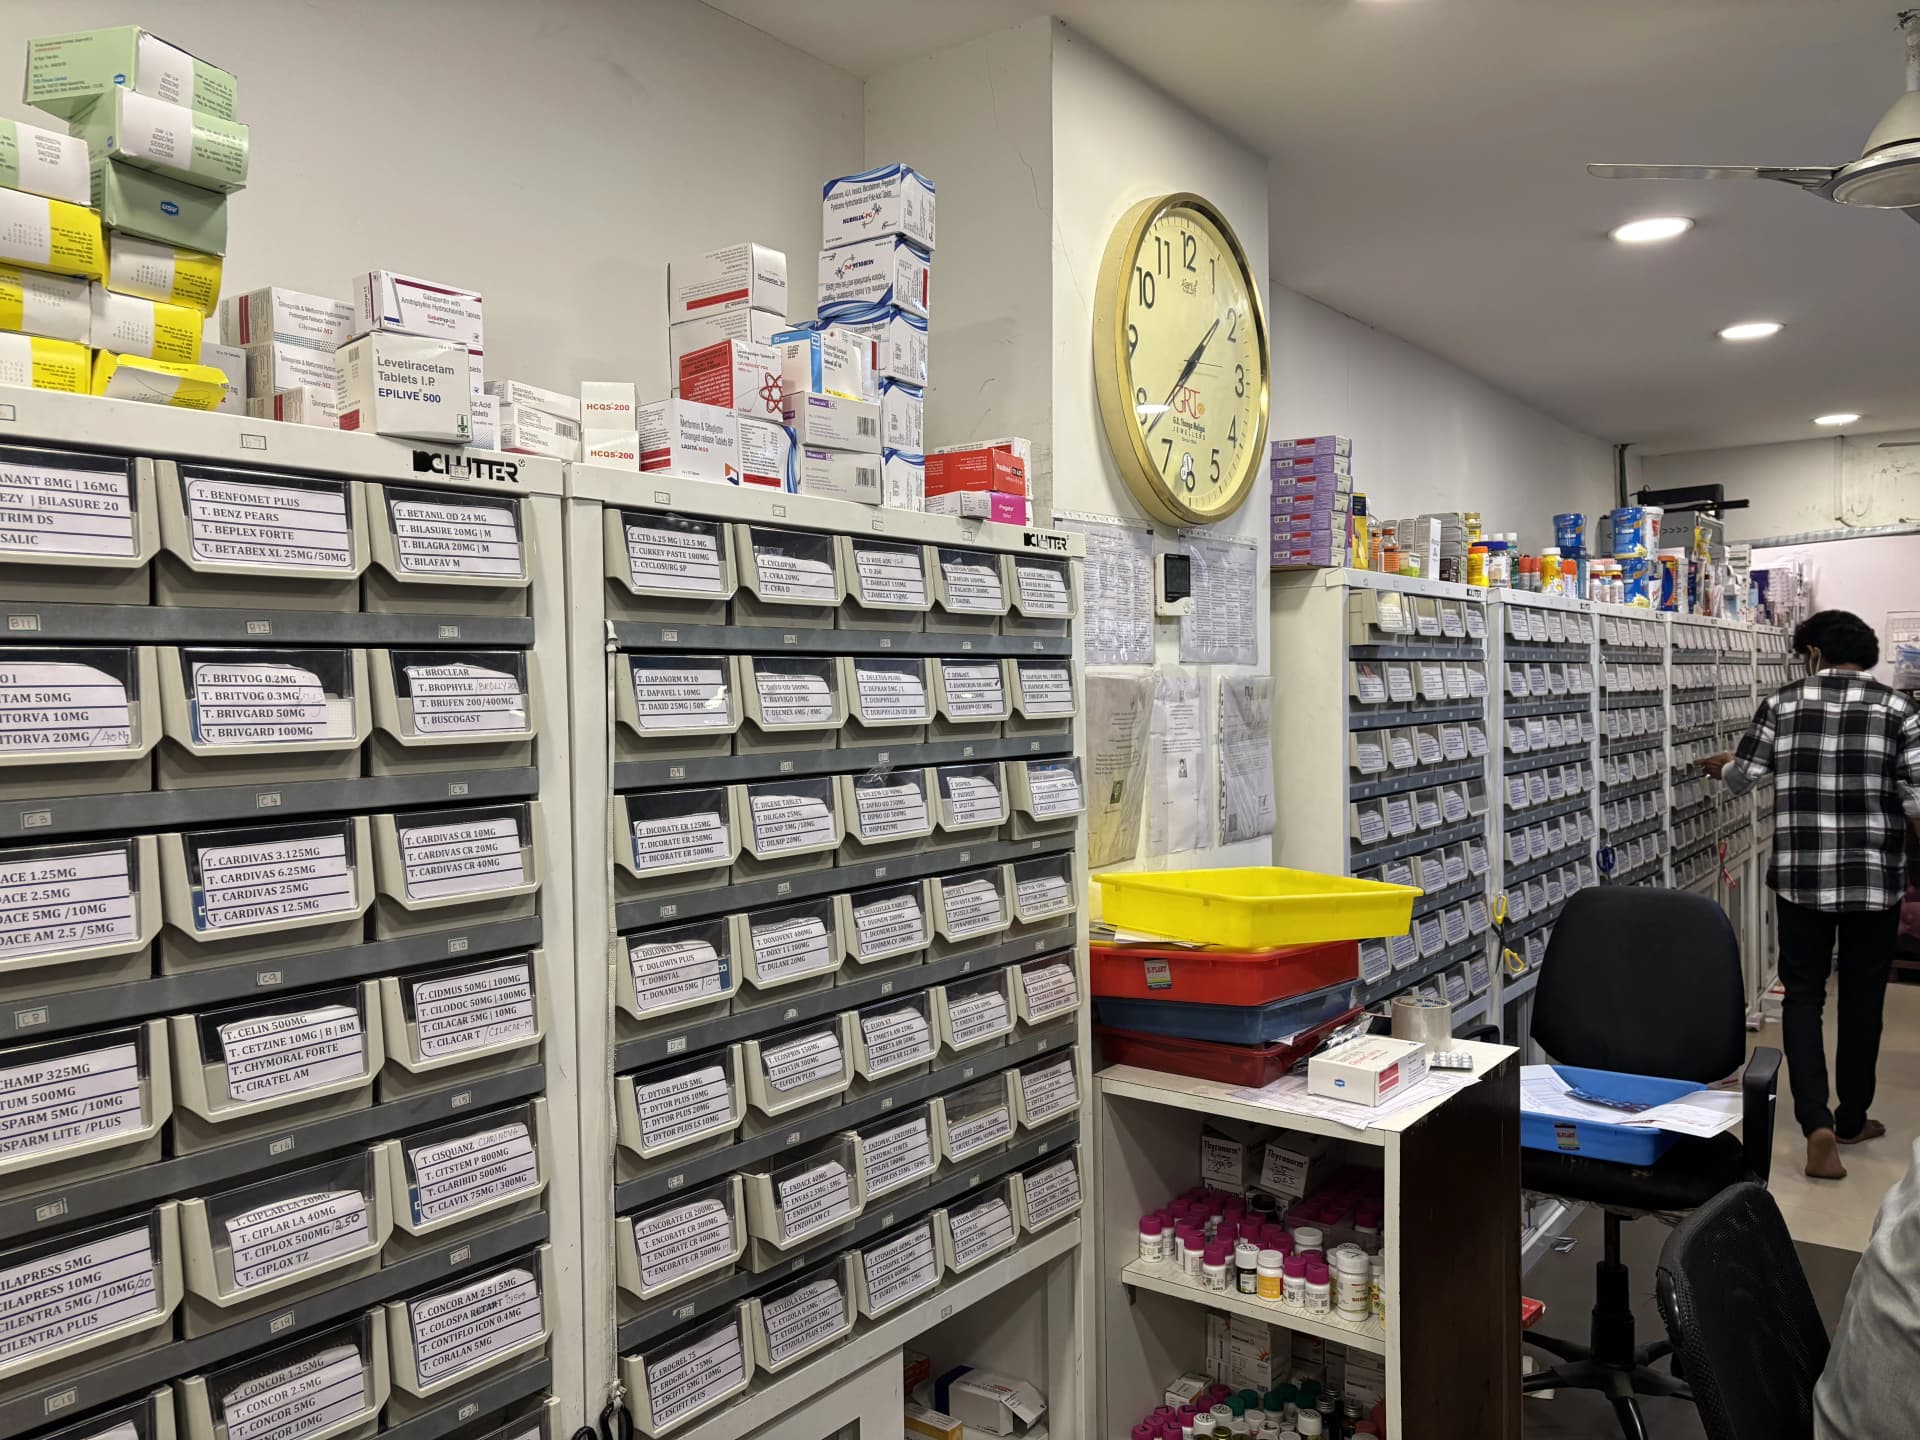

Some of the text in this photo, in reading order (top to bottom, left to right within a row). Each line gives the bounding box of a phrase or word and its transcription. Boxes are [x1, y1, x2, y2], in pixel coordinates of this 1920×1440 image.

[1155, 236, 1170, 279] 11
[1181, 230, 1196, 272] 12
[1209, 258, 1215, 295] 1
[1136, 266, 1155, 309] 10
[1227, 307, 1237, 343] 2
[1129, 324, 1138, 360] 9
[377, 356, 454, 375] Levetiracetam
[378, 371, 435, 386] Tablets I.P.
[1234, 363, 1245, 398] 3
[378, 388, 441, 403] EPILIVE 500
[586, 403, 630, 411] HCQS-200
[1227, 415, 1237, 449] 4
[590, 450, 634, 460] HCQS-200
[1161, 438, 1173, 475] 7
[1210, 448, 1220, 483] 5
[38, 497, 101, 509] BILASURE
[102, 501, 119, 511] 20
[196, 488, 299, 507] T. BENFOMET PLUS
[36, 514, 53, 524] DS
[201, 524, 294, 540] T. BEPLEX FORTE
[201, 543, 346, 561] T. BETABEX XL 25MG/50MG
[630, 546, 638, 555] T.
[665, 549, 687, 558] PASTE
[687, 552, 709, 560] 100MG
[199, 673, 296, 684] T. BRITVOG 0.2MG
[419, 697, 514, 708] T. BRUFEN 200/400MG
[203, 726, 312, 738] T. BRIVGARD 100MG
[403, 828, 496, 846] T. CARDIVAS CR 10MG
[204, 847, 320, 867] T. CARDIVAS 3.125MG
[640, 855, 648, 863] T.
[647, 851, 682, 862] DICORATE
[692, 847, 714, 855] 500MG
[29, 868, 76, 880] 1.25MG
[33, 930, 54, 941] AM
[57, 927, 76, 938] 2.5
[80, 923, 114, 937] /5MG
[638, 955, 694, 972] T. DOLOWIN PLUS
[223, 1016, 307, 1040] T. CELIN 500MG
[230, 1043, 338, 1075] T. CHYMORAL FORTE
[31, 1087, 75, 1103] 500MG
[50, 1105, 78, 1119] 5MG
[81, 1096, 122, 1114] /10MG
[644, 1115, 719, 1144] T. DYTOR PLUS LS 10MG
[424, 1148, 509, 1180] T. CITSTEM P 800MG
[425, 1165, 507, 1196] T. CLARIBID 500MG
[239, 1206, 336, 1243] T. CIPLAR LA 40MG
[643, 1217, 718, 1248] T. ENCORATE CR 300MG
[64, 1295, 92, 1311] 5MG
[66, 1316, 98, 1332] PLUS
[420, 1308, 521, 1353] T. CONTIFLO ICON 0.4MG
[421, 1337, 492, 1371] T. CORALAN 5MG
[651, 1352, 698, 1379] T. EROGREL 75
[233, 1379, 321, 1418] T. CONCOR 2.5MG
[657, 1412, 665, 1421] T.
[689, 1391, 705, 1406] PLUS
